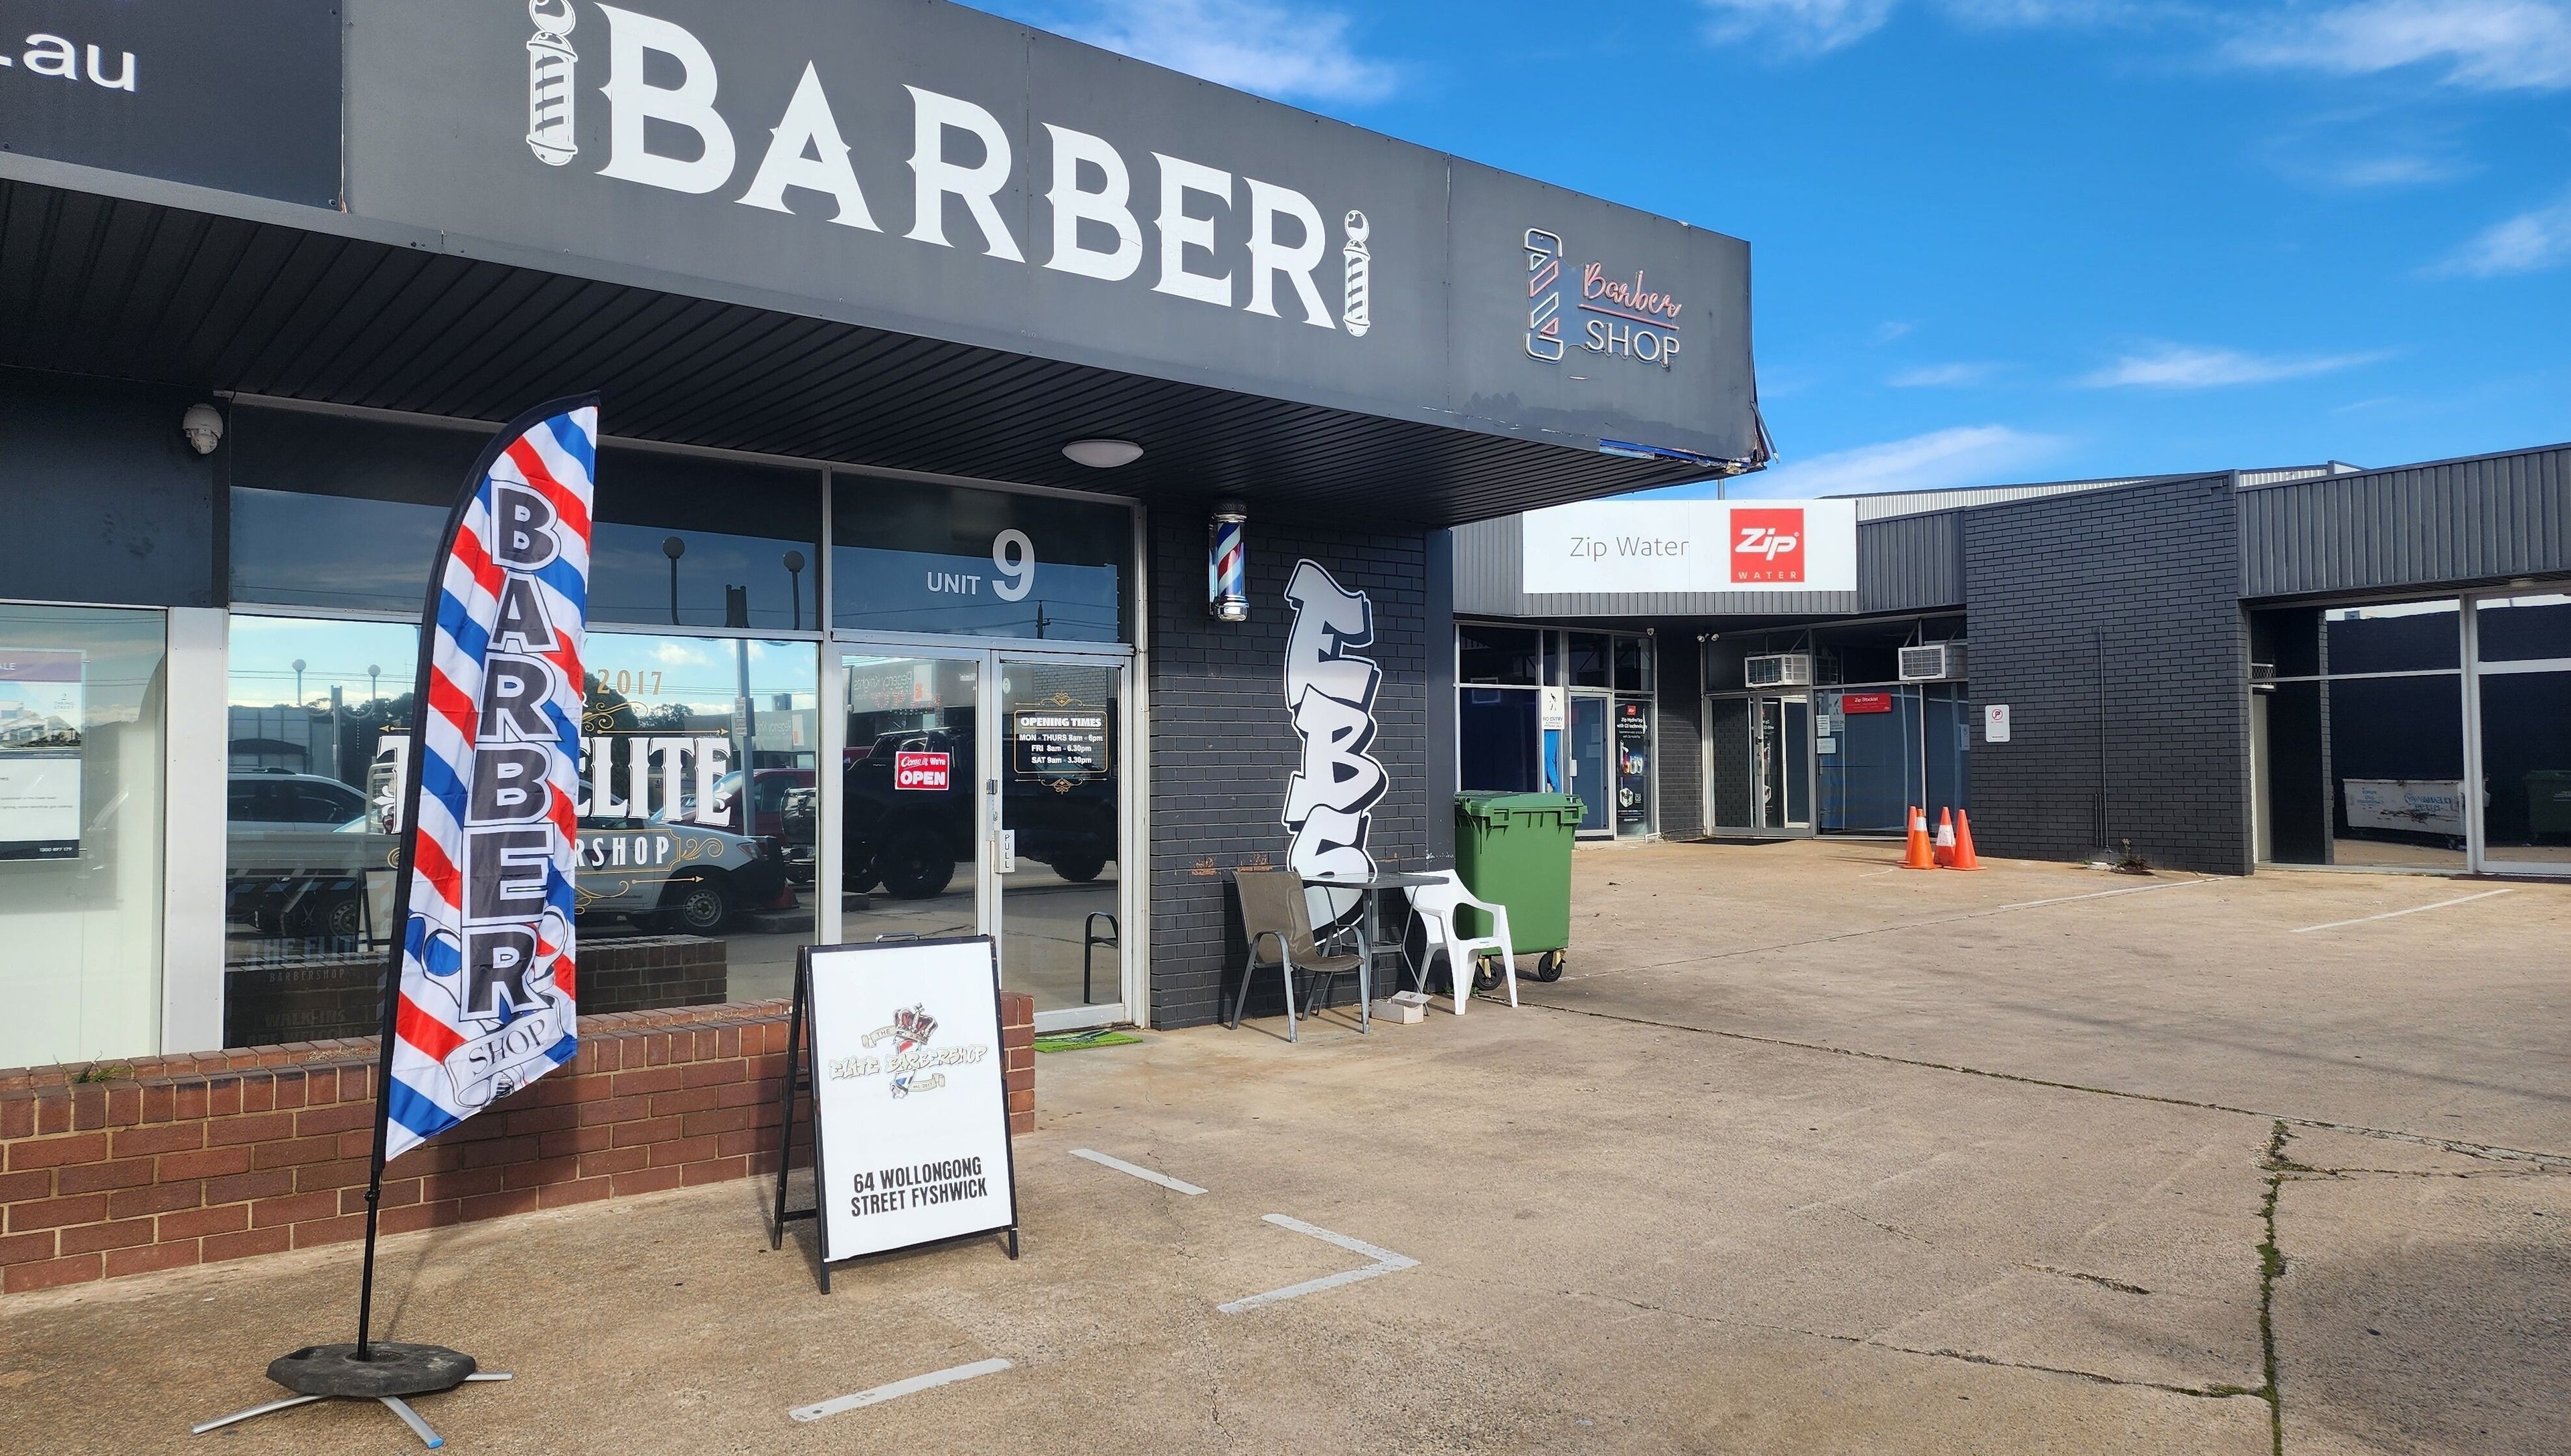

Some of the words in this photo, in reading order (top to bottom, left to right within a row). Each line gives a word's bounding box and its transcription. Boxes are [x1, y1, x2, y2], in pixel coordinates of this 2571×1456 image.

[594, 2, 1336, 331] BARBER
[1583, 262, 1683, 319] Barber
[1585, 319, 1681, 367] SHOP
[1570, 536, 1608, 562] Zip
[1616, 536, 1689, 557] Water
[927, 571, 981, 595] UNIT
[992, 528, 1035, 602] 9
[1738, 571, 1797, 580] WATER
[597, 669, 662, 695] 2017
[1020, 717, 1069, 727] OPENING
[1071, 718, 1102, 728] TIMES
[459, 479, 562, 1022] BARBER
[901, 756, 921, 767] Come
[930, 757, 946, 766] We're
[900, 770, 946, 786] OPEN
[269, 968, 345, 983] BARBERSHOP
[876, 1028, 890, 1038] THE
[469, 1019, 547, 1076] SHOP
[886, 1045, 988, 1073] BARBERSHOP
[854, 1171, 875, 1194] 64
[880, 1156, 982, 1190] WOLLONGONG
[851, 1190, 906, 1217] STREET
[911, 1178, 988, 1208] FYSHWICK
